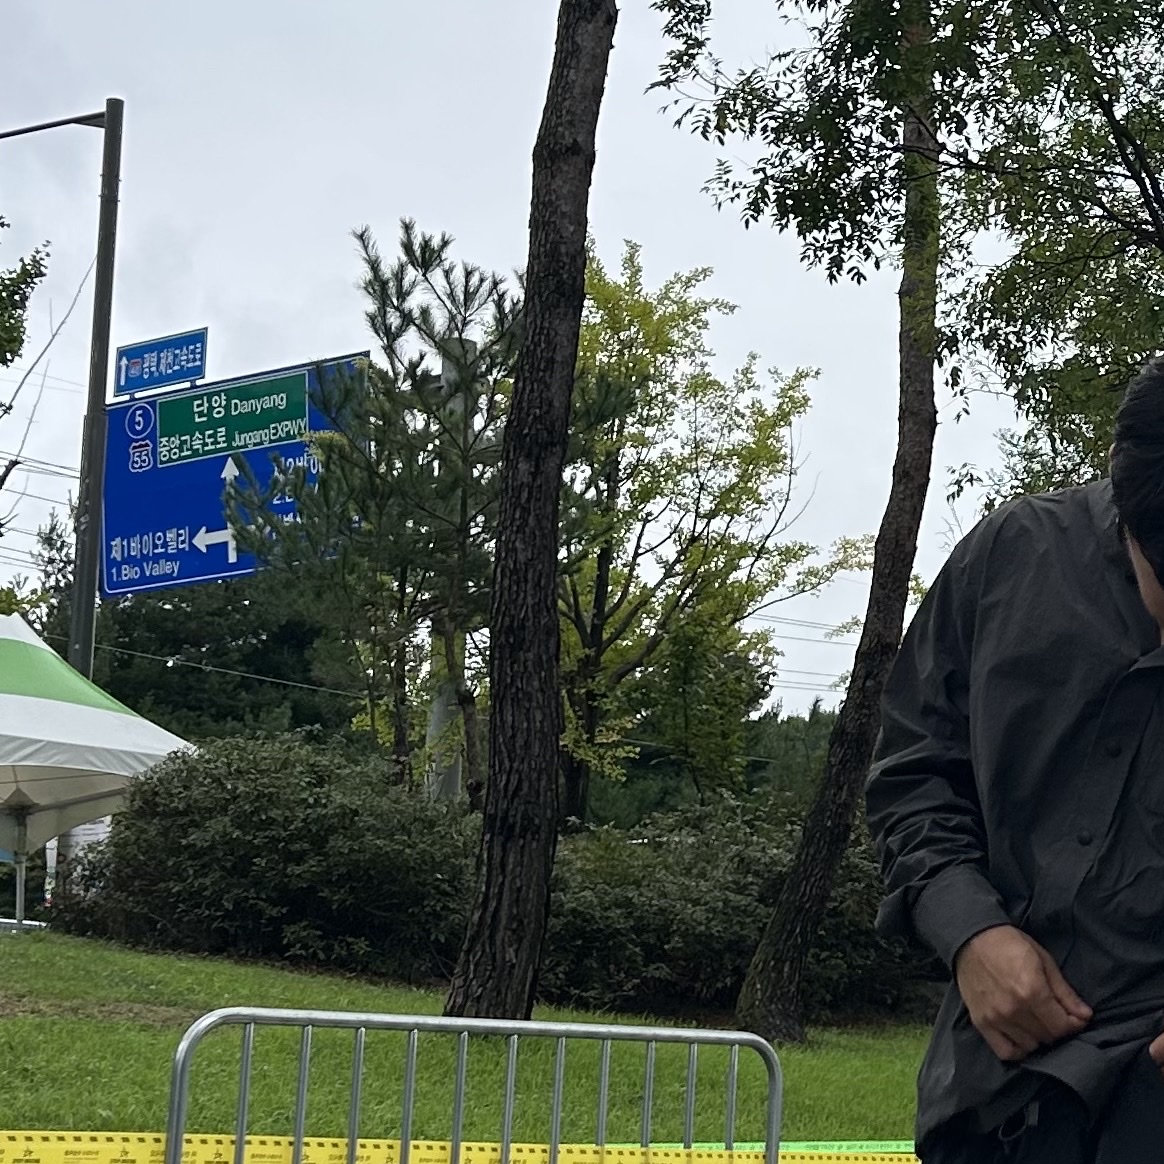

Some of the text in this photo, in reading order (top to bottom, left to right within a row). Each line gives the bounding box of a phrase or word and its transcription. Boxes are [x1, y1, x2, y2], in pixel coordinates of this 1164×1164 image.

[231, 393, 287, 416] Danyang
[135, 409, 144, 431] 5
[159, 426, 228, 461] 중앙고속도로
[132, 450, 149, 469] 55
[142, 558, 180, 577] Valley
